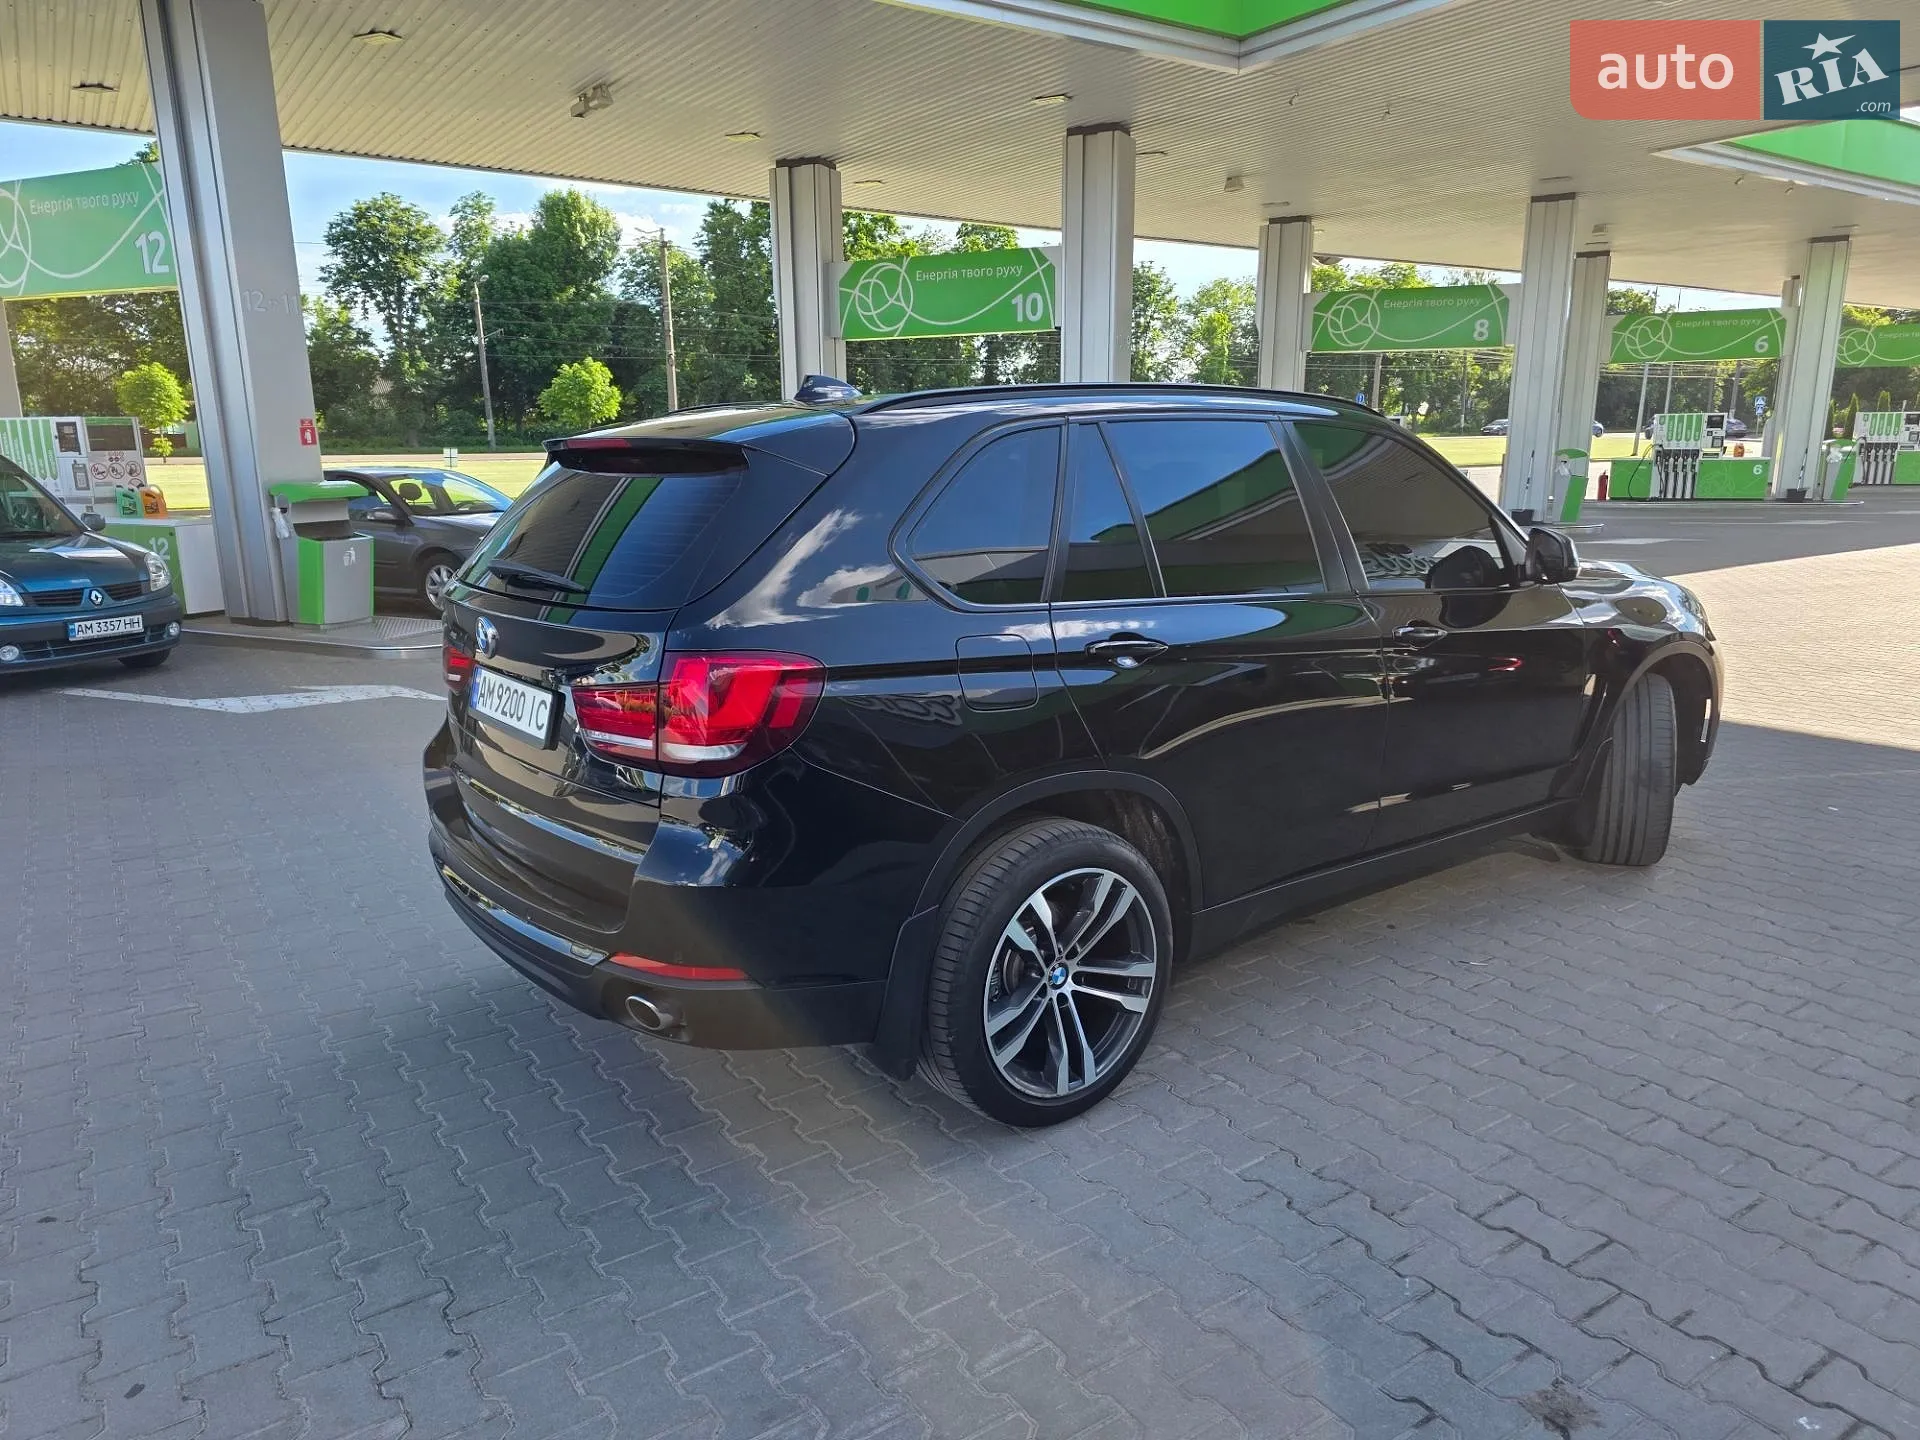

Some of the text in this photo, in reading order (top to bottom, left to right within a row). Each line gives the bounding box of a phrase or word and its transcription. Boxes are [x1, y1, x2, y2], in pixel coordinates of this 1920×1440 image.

[29, 190, 140, 216] Енергія твого руху
[134, 230, 169, 275] 12
[916, 263, 1023, 284] Енергія твого руху
[1011, 292, 1044, 322] 10
[1383, 296, 1480, 310] Енергія твого руху
[1472, 318, 1490, 341] 8
[1754, 335, 1769, 353] 6
[1752, 464, 1763, 475] 6
[148, 536, 171, 560] 12
[76, 618, 140, 635] AM 3357 HH
[477, 676, 496, 711] AM
[495, 683, 526, 722] 9200
